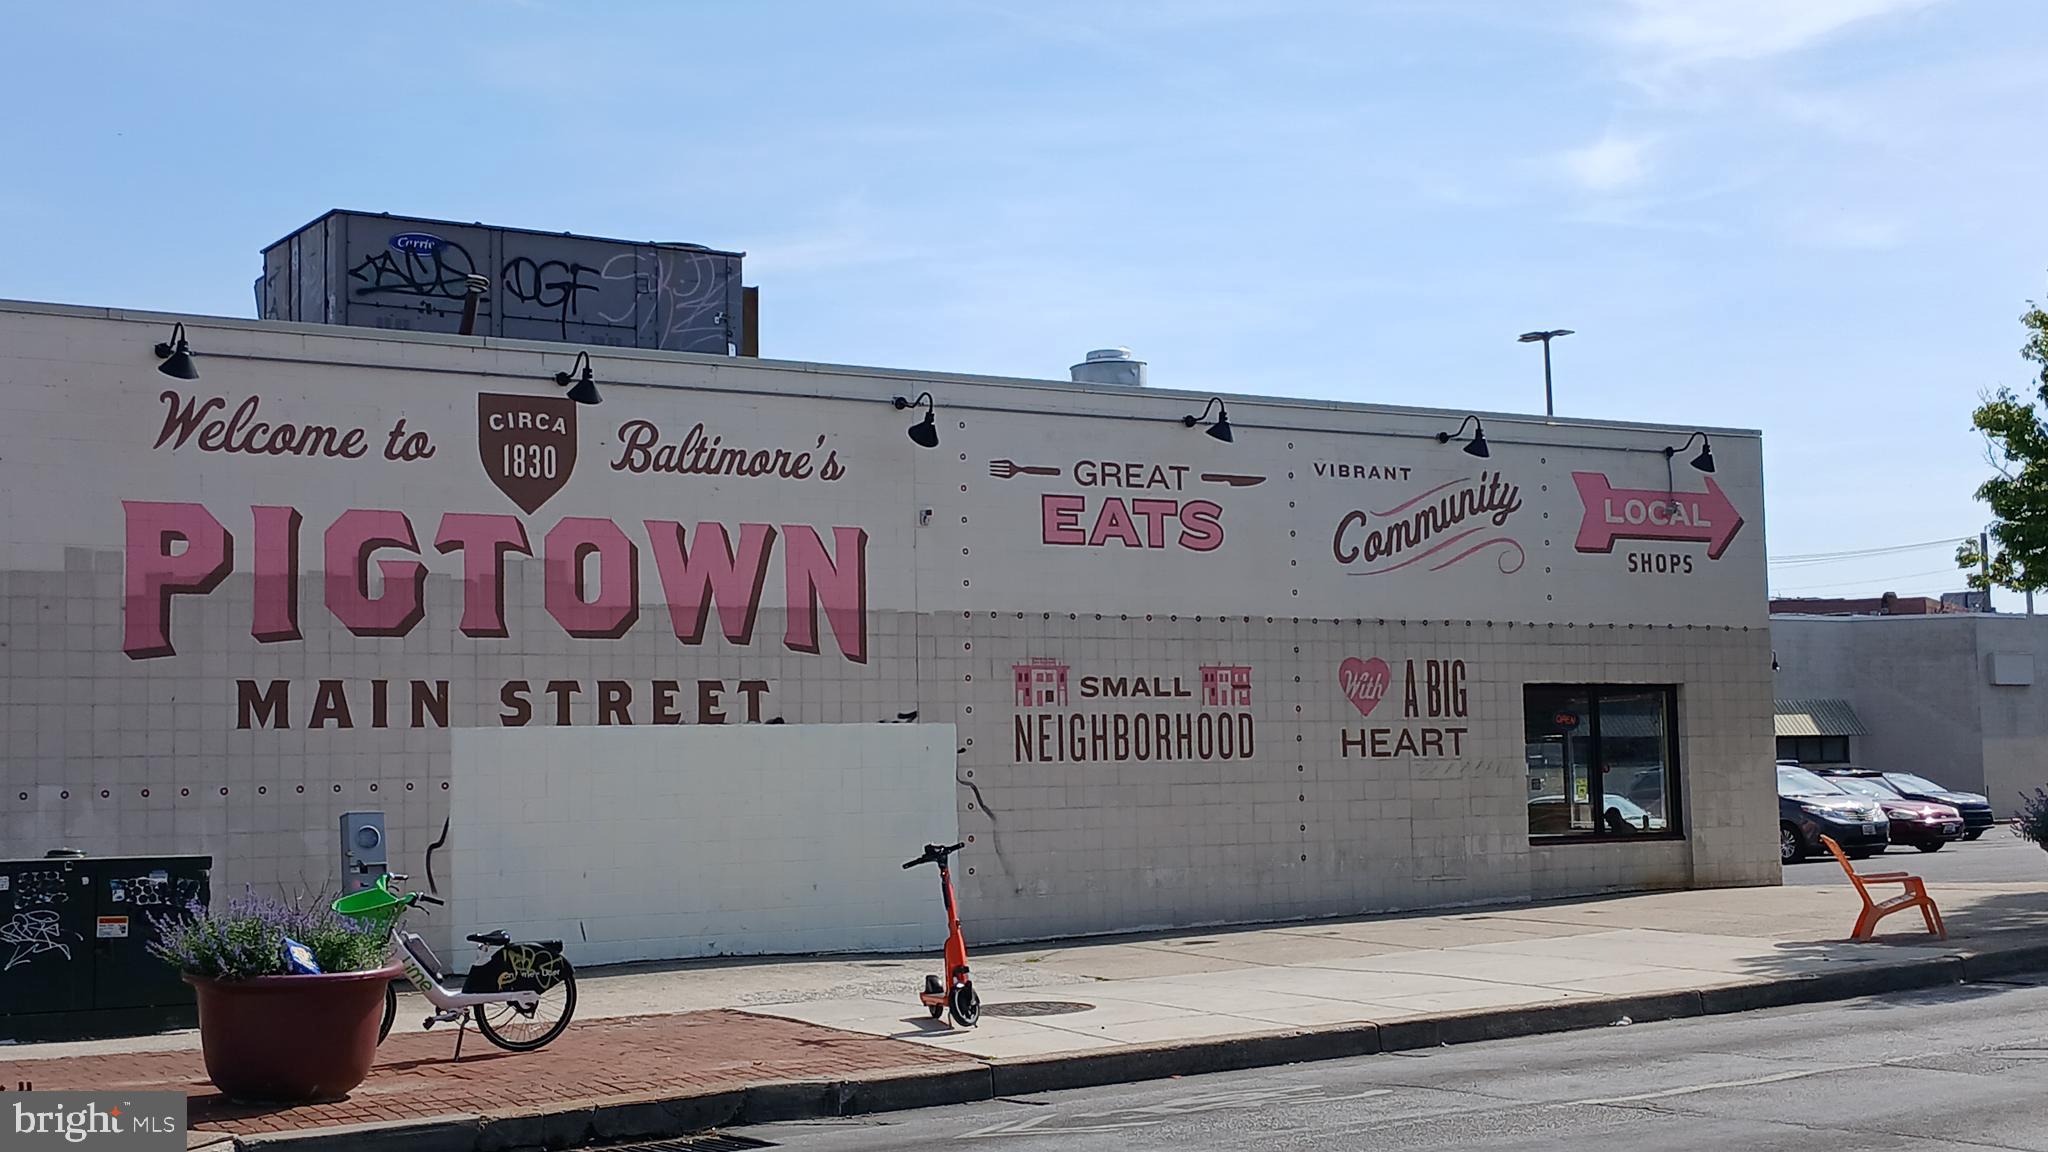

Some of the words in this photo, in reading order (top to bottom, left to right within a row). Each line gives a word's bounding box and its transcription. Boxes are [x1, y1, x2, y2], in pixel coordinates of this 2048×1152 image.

[153, 390, 369, 459] Welcome
[383, 418, 437, 462] to
[488, 411, 568, 435] CIRCA
[502, 442, 557, 480] 1830
[610, 418, 847, 482] Baltimore's
[1073, 460, 1190, 491] GREAT
[1313, 462, 1412, 482] VIBRANT
[1041, 493, 1225, 552] EATS
[1332, 469, 1523, 565] Community
[1604, 498, 1712, 528] LOCAL
[122, 500, 868, 664] PIGTOWN
[1628, 552, 1694, 575] SHOPS
[236, 679, 450, 730] MAIN
[499, 679, 771, 728] STREET
[1079, 675, 1192, 698] SMALL
[1343, 668, 1385, 701] With
[1403, 659, 1419, 719] A
[1428, 659, 1468, 719] BIG
[1014, 711, 1255, 764] NEIGHBORHOOD
[1555, 713, 1577, 726] OPEN
[1341, 727, 1469, 758] HEART
